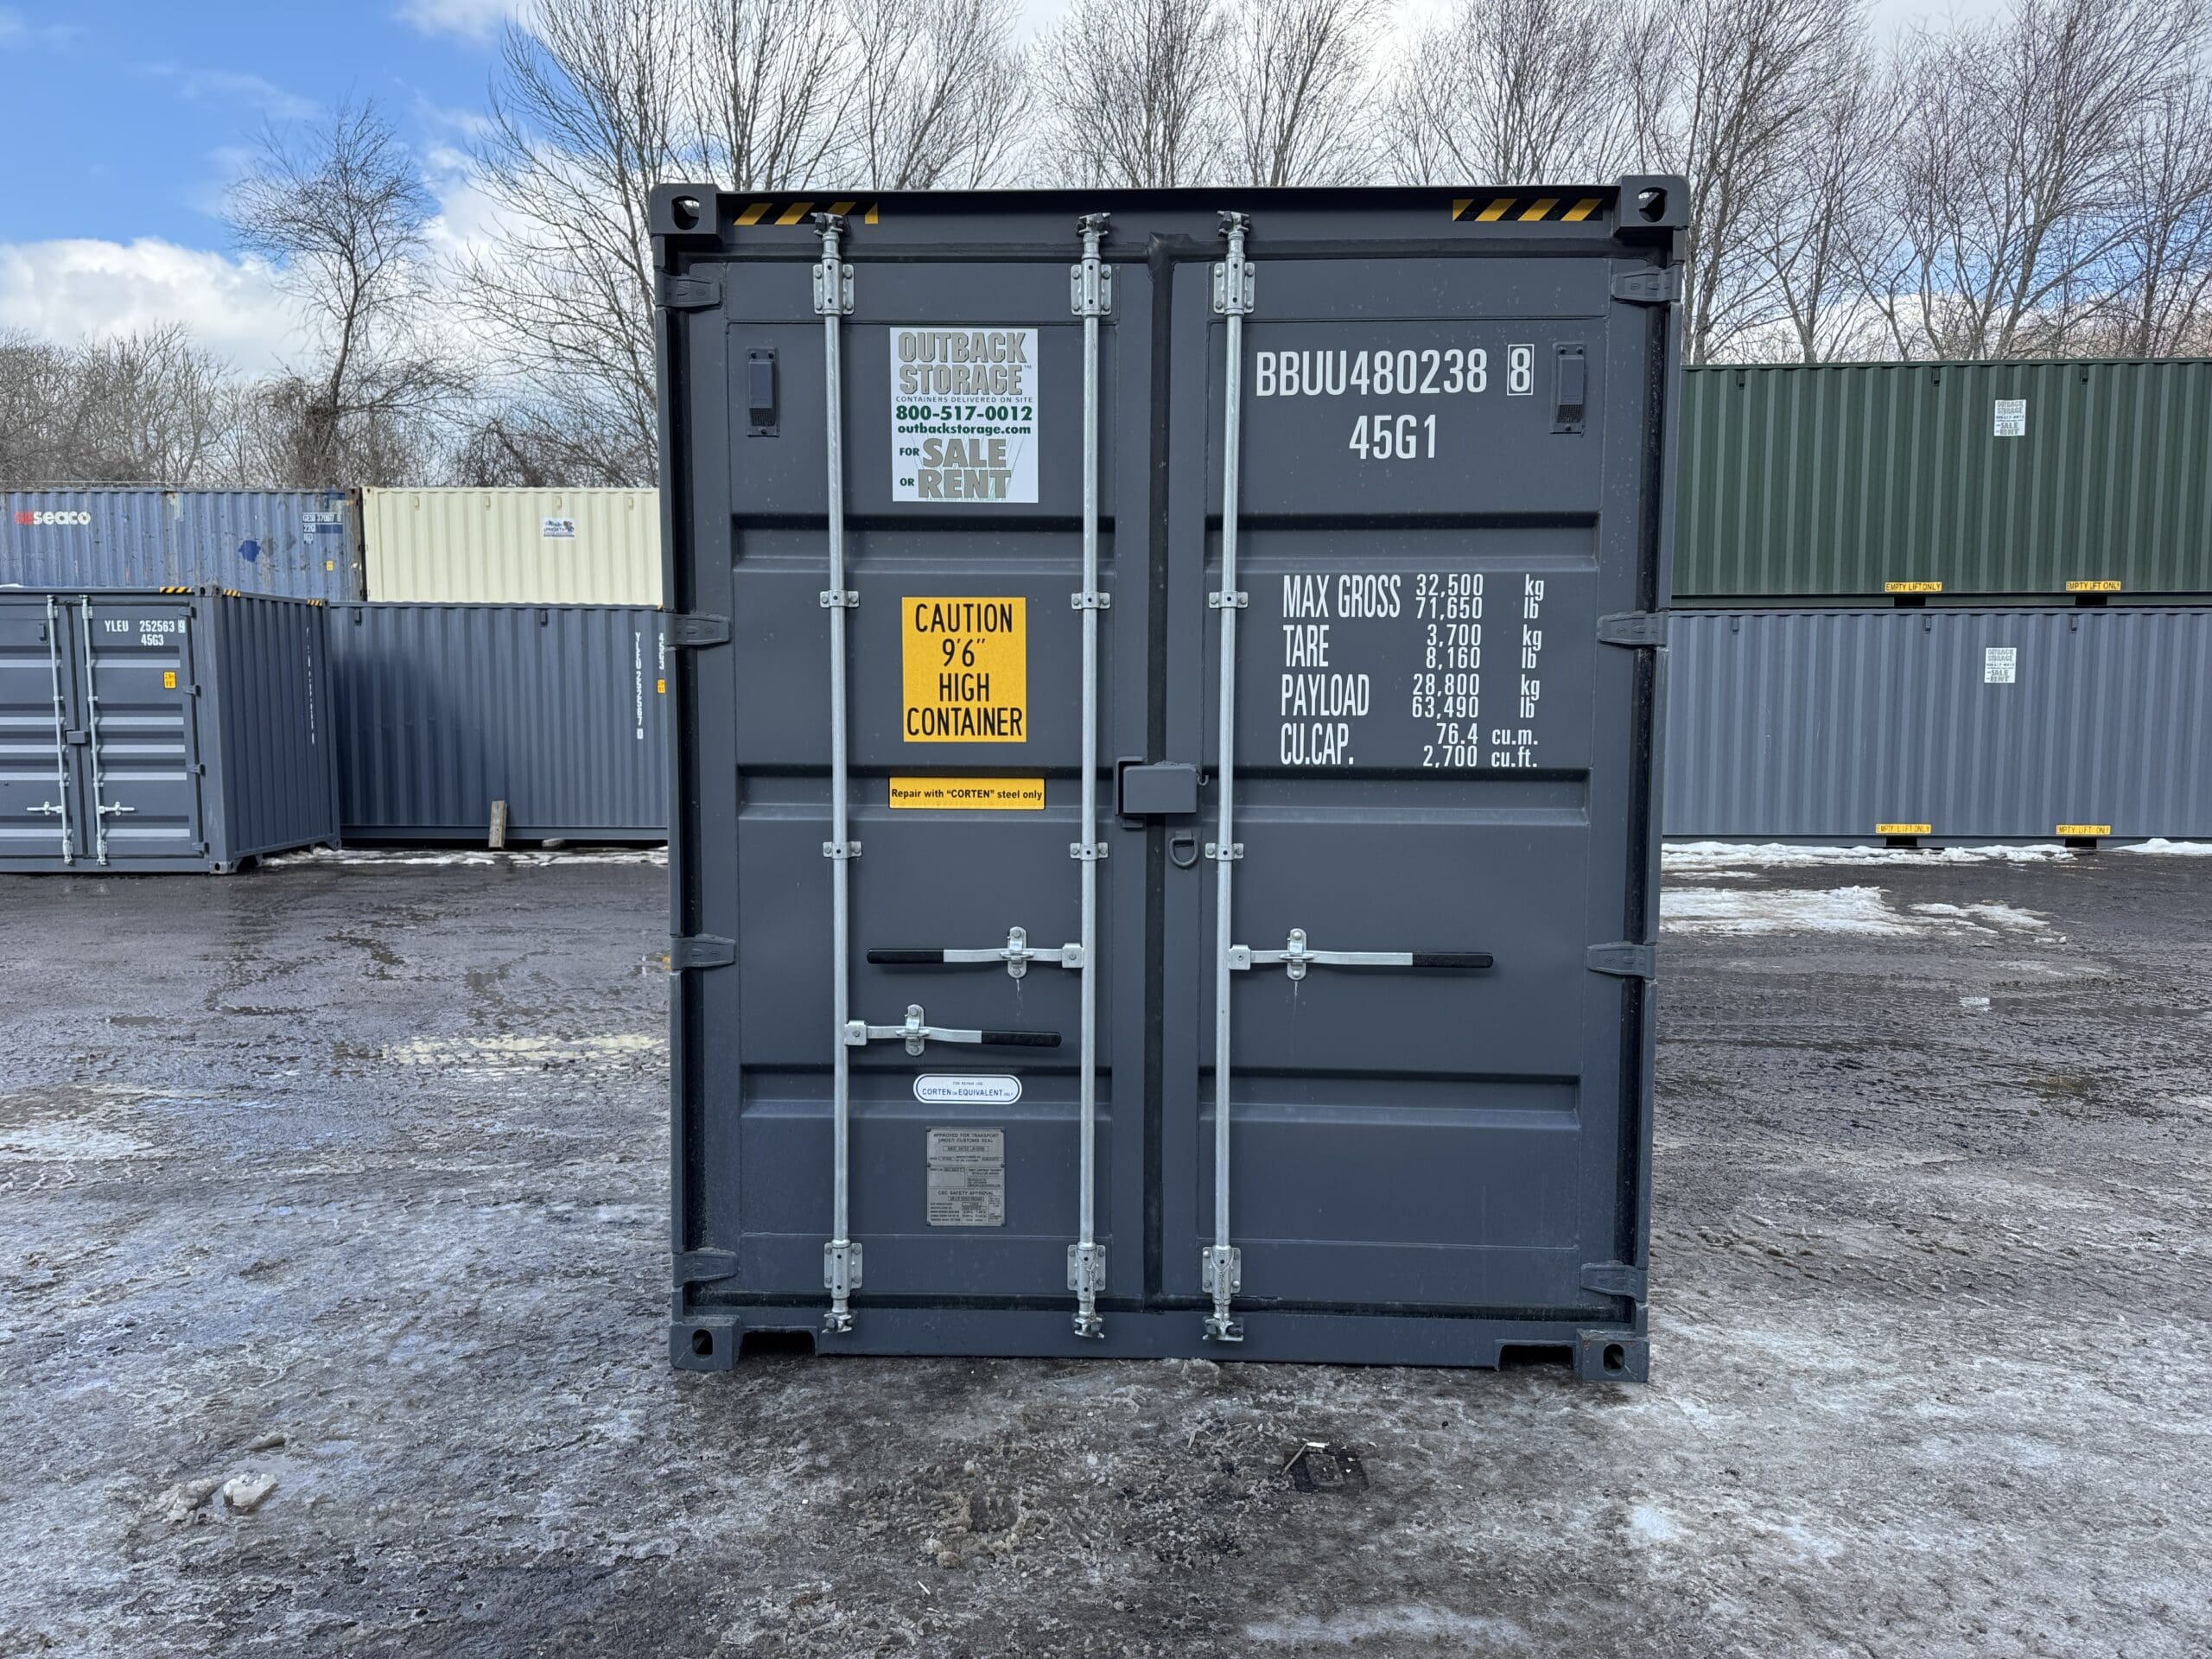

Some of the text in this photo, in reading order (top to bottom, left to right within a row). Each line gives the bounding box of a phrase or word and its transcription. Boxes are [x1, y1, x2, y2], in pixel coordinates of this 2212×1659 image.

[899, 332, 1027, 363] OUTBACK
[899, 365, 1022, 395] STORAGE
[1255, 348, 1531, 396] BBUU480238 8
[896, 405, 1033, 421] 800-517-0012
[898, 423, 1031, 435] outbackstorage.com
[1349, 414, 1436, 460] 45G1
[899, 438, 1007, 467] FOR SALE
[899, 469, 1012, 499] OR RENT
[1283, 573, 1544, 618] MAX GROSS 32,500 kg
[1415, 596, 1539, 620] 71,650 lb
[105, 620, 129, 632] YLEU
[139, 620, 175, 632] 252563
[915, 603, 1013, 633] CAUTION
[141, 633, 164, 645] 45G3
[1282, 624, 1542, 667] TARE 3,700 kg
[1426, 646, 1537, 670] 8,160 lb
[939, 672, 989, 702] HIGH
[1281, 673, 1540, 716] PAYLOAD 28,800 kg
[907, 708, 1022, 736] CONTAINER
[1412, 696, 1535, 719] 63,490 lb
[1280, 722, 1538, 765] CU.CAP. 76.4 cu.m.
[1423, 746, 1537, 768] 2,700 cu.ft.
[892, 788, 921, 799] Repair
[924, 789, 944, 798] with
[997, 790, 1020, 798] steel
[1023, 790, 1042, 801] only
